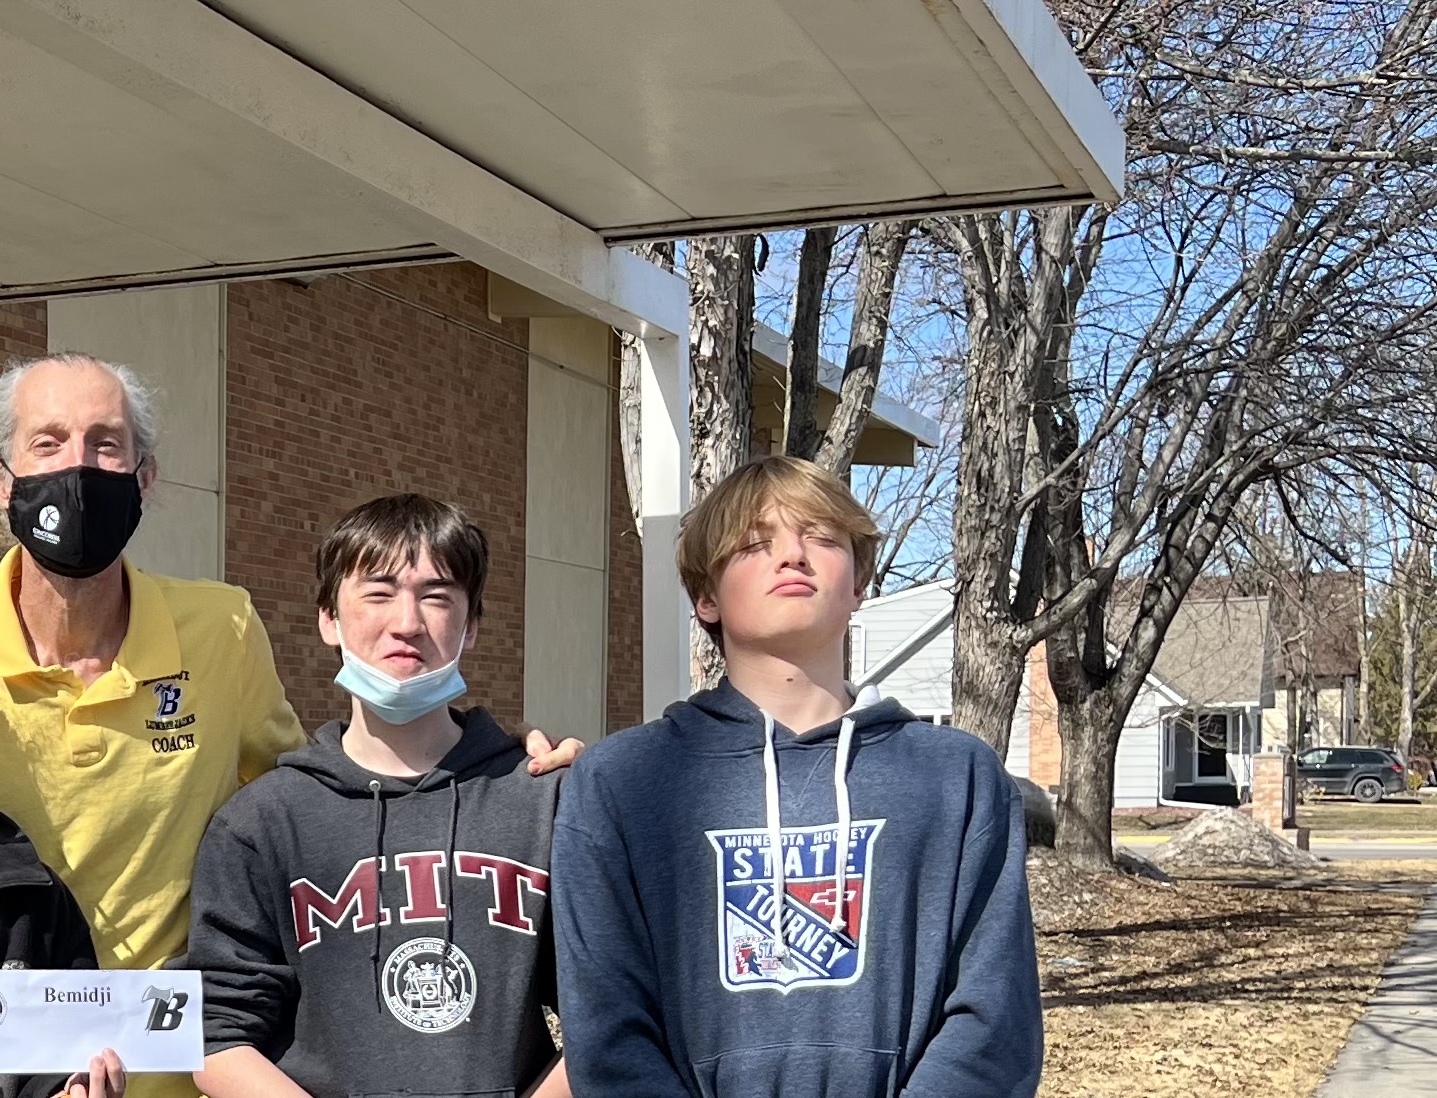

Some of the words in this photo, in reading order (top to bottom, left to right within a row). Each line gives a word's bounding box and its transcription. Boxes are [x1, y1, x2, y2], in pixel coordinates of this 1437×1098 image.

[152, 733, 195, 754] COACH
[724, 833, 805, 849] MINNEOTA
[814, 827, 868, 845] HOCEY
[289, 850, 550, 954] MIT
[44, 986, 112, 1007] Bemidji
